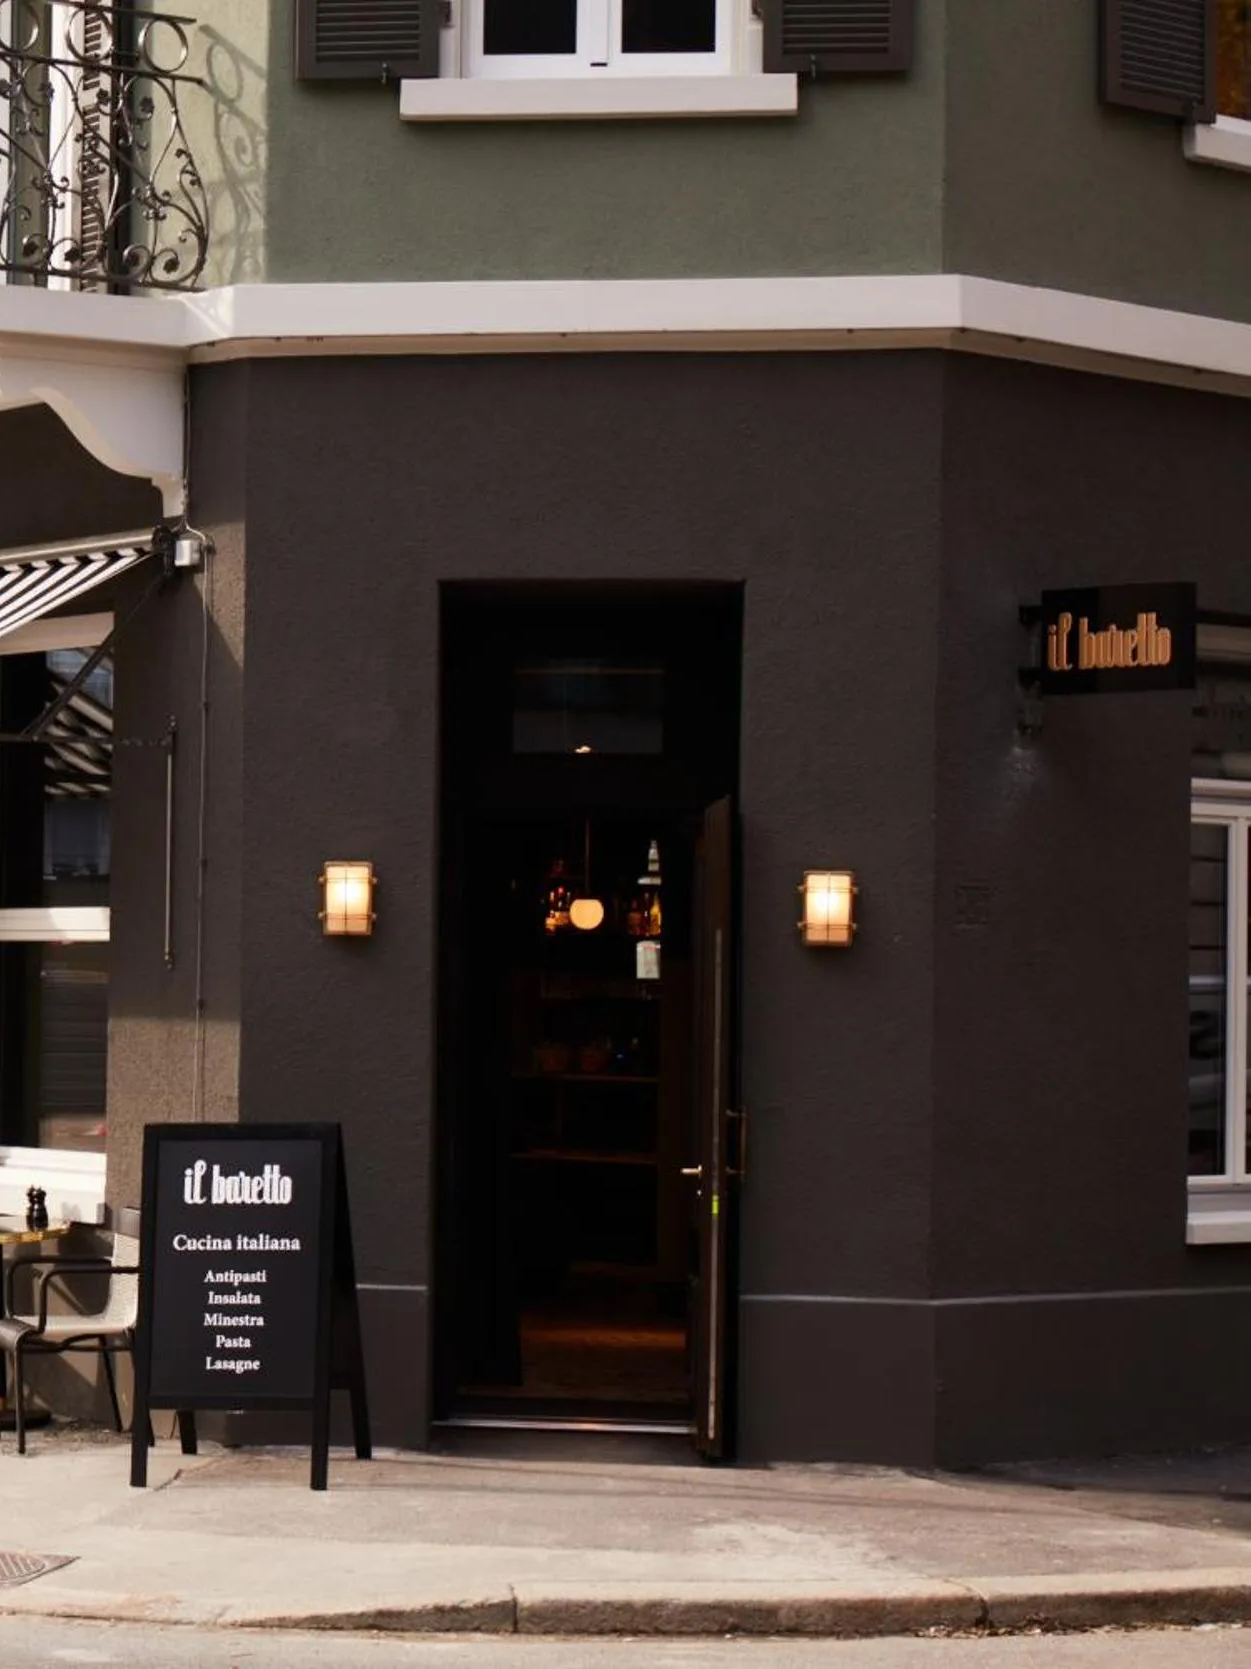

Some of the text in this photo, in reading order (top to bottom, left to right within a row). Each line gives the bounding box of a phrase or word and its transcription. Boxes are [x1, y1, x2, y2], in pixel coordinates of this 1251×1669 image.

[1048, 611, 1172, 671] il baretto
[183, 1159, 292, 1204] il baretto
[172, 1233, 301, 1251] Cucina italiana
[203, 1269, 267, 1286] Antipasti
[207, 1290, 262, 1305] Insalata
[203, 1312, 265, 1326] Minestra
[215, 1334, 251, 1348] Pasta
[205, 1356, 261, 1374] Lasagne
